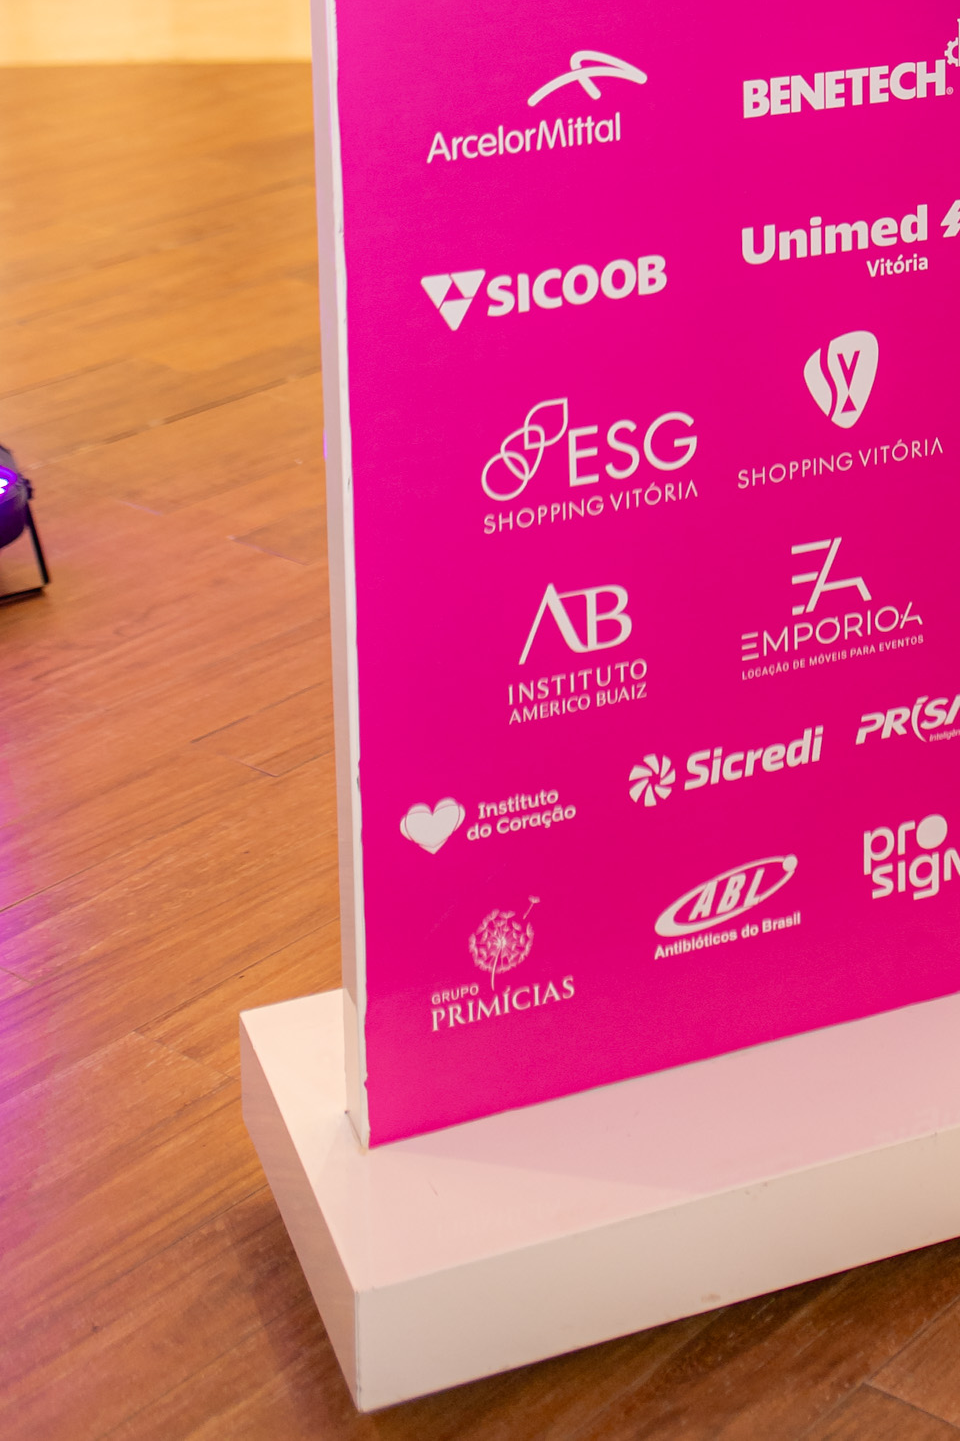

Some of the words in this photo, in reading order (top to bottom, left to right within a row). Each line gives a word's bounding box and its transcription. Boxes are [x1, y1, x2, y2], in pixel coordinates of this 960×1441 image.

[427, 111, 621, 164] ArcelorMittal
[741, 204, 928, 265] Unimed
[487, 254, 667, 317] SICOOB
[866, 253, 929, 278] Vitória
[568, 411, 697, 487] ESG
[738, 452, 853, 489] SHOPPING
[859, 437, 943, 467] VITÓRIA
[483, 495, 604, 534] SHOPPING
[610, 479, 698, 511] VITÓRIA
[518, 582, 632, 665] AB
[508, 658, 648, 705] INSTITUTO
[742, 661, 790, 681] LOCAÇÃO
[792, 659, 806, 670] DE
[809, 649, 847, 667] MÓVEIS
[850, 644, 876, 658] PARA
[879, 634, 924, 652] EVENTOS
[509, 693, 591, 725] AMERICO
[596, 681, 648, 708] BUAIZ
[684, 725, 824, 791] Sicredi
[466, 823, 492, 841] do
[496, 804, 577, 835] Coração
[478, 789, 559, 820] Instituto
[688, 867, 765, 922] ABL
[654, 929, 738, 960] Antibióticos
[741, 924, 759, 939] do
[762, 911, 801, 934] Brasil
[431, 983, 479, 1005] GRUPO
[431, 974, 575, 1033] PRIMÍCIAS
